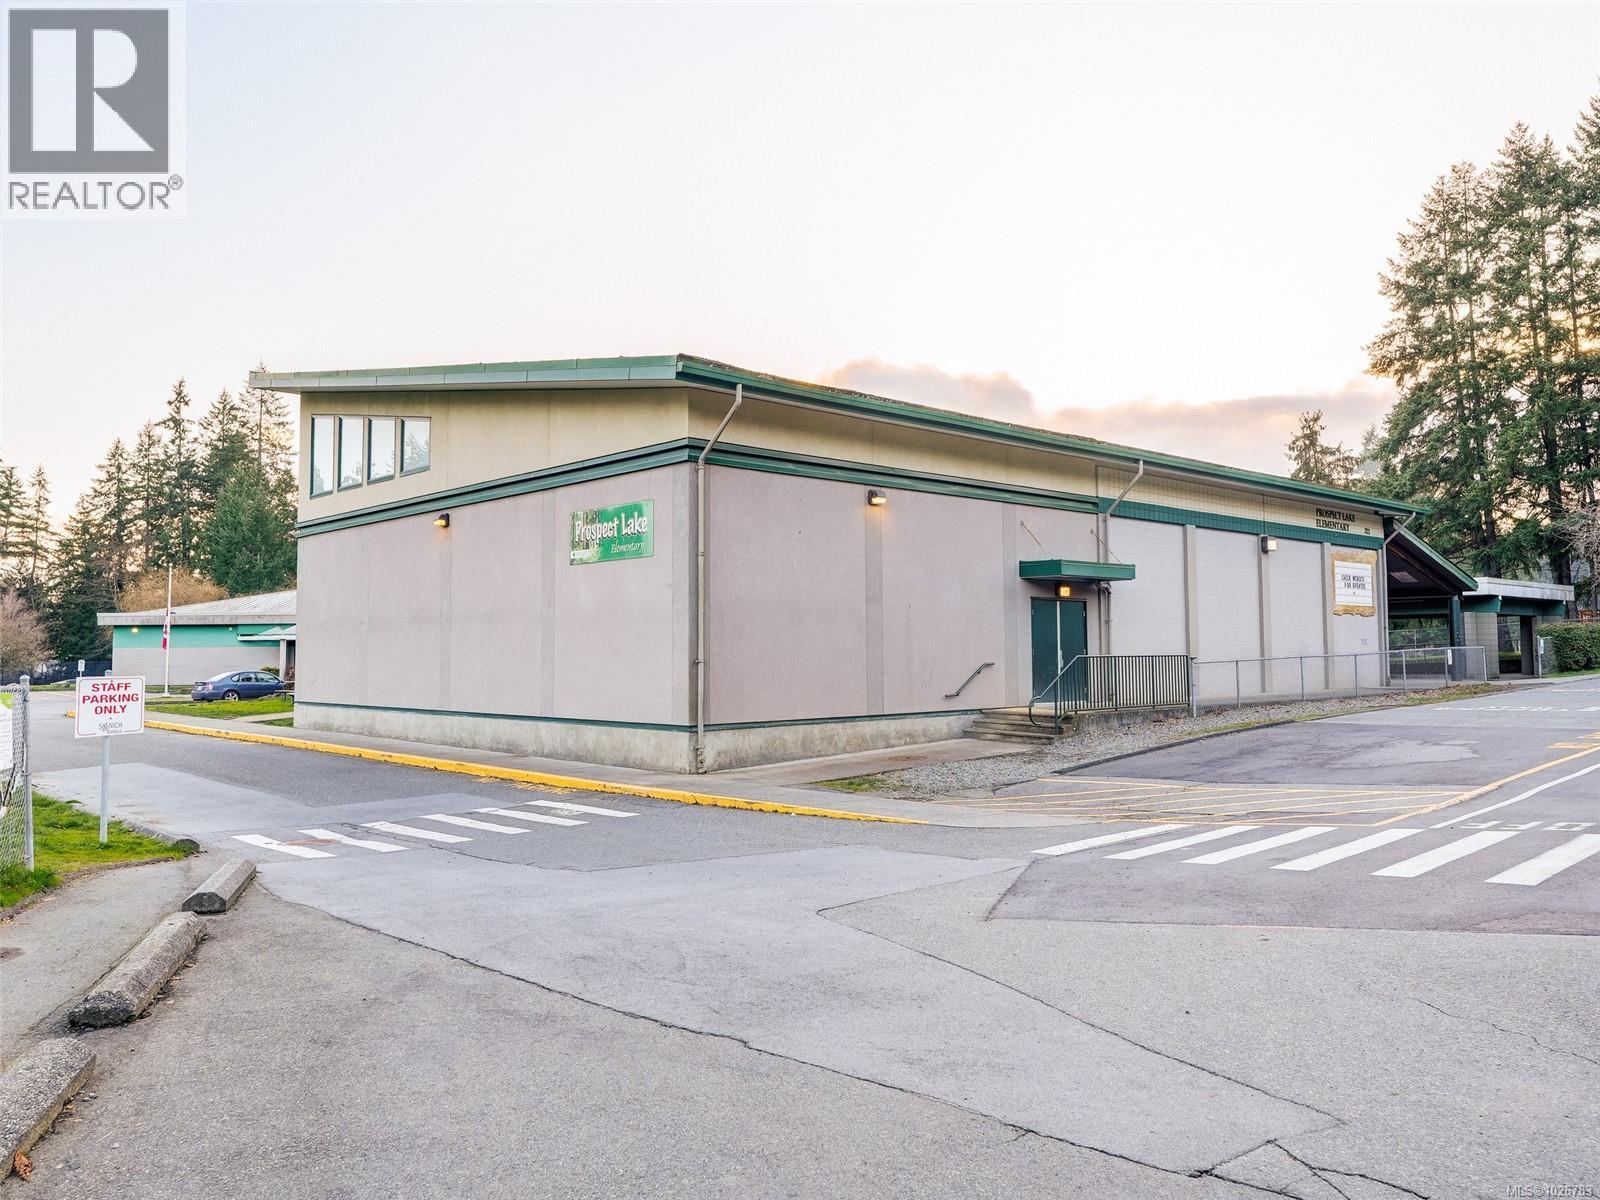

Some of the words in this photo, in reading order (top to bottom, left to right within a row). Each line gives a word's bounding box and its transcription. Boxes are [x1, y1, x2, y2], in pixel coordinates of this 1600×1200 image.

[1316, 508, 1342, 520] PROSPECT
[1342, 512, 1356, 522] LAKE
[574, 517, 619, 545] Prospect
[621, 511, 647, 537] Lake
[1316, 519, 1350, 531] ELEMENTARY
[610, 541, 645, 554] Elementary
[91, 682, 132, 692] STAFF
[82, 693, 139, 704] PARKING
[94, 705, 127, 715] ONLY
